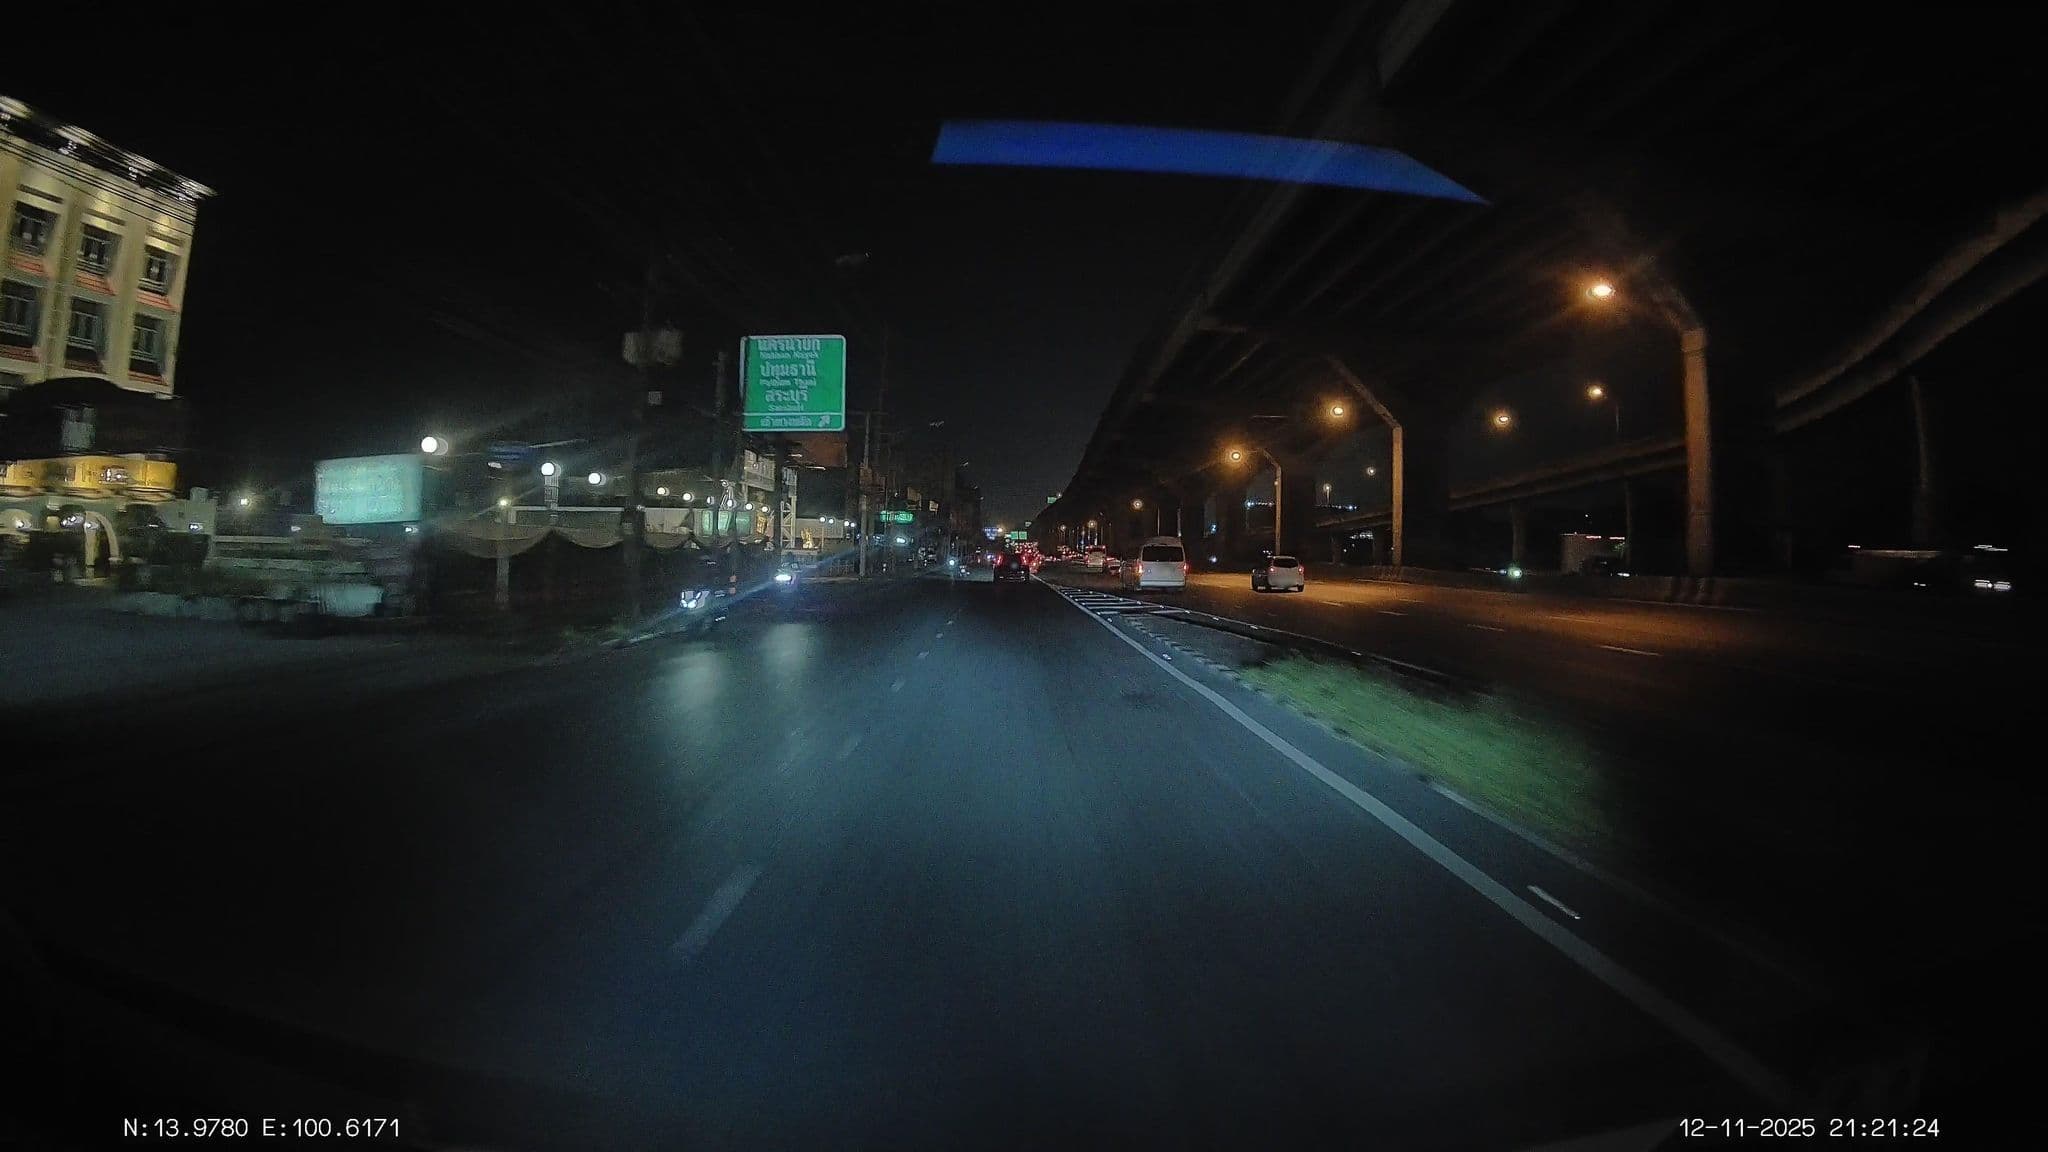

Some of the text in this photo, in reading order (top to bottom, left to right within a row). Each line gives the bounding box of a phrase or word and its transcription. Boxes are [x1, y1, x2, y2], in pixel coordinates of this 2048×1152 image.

[759, 359, 817, 378] ปทุมธานี
[765, 386, 808, 404] สระบุรี
